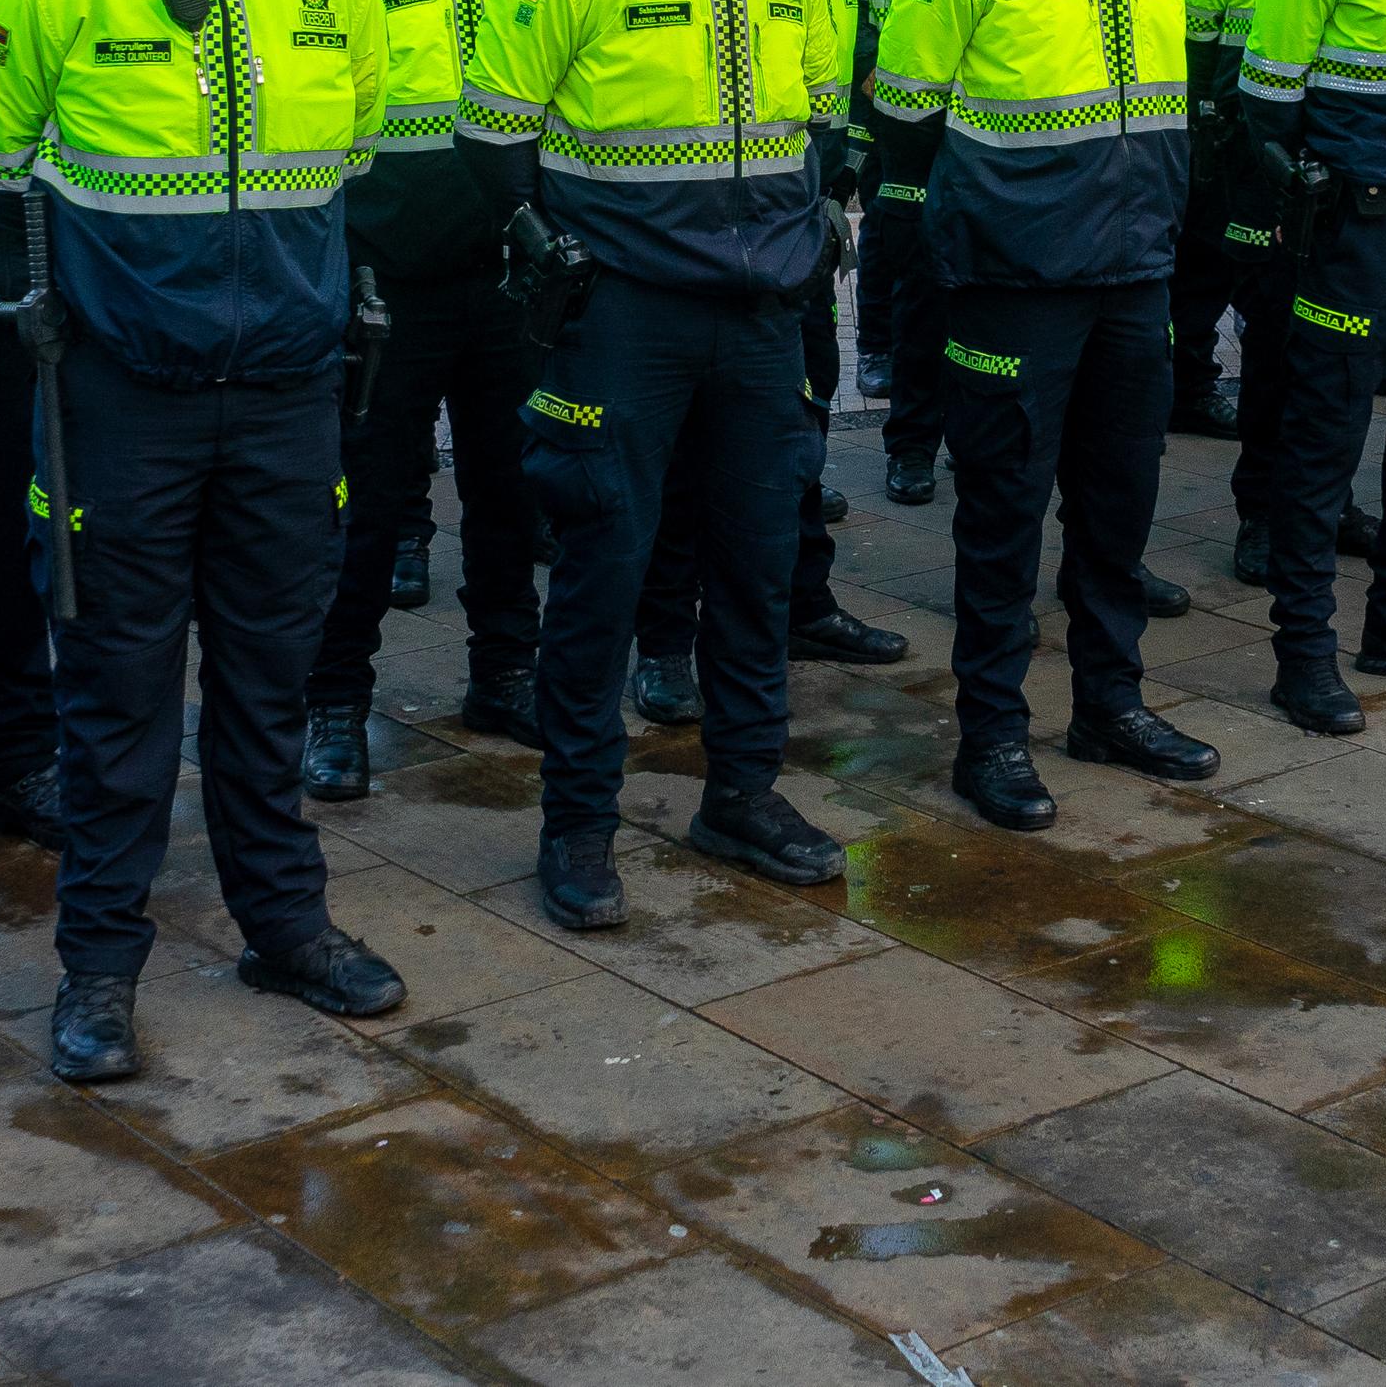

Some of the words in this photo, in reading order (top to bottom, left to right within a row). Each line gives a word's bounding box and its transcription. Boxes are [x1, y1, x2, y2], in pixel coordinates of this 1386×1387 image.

[296, 34, 345, 47] POLICÍA
[110, 42, 153, 52] Patrullero
[95, 52, 126, 63] CARLOS
[127, 51, 170, 62] QUINTERO
